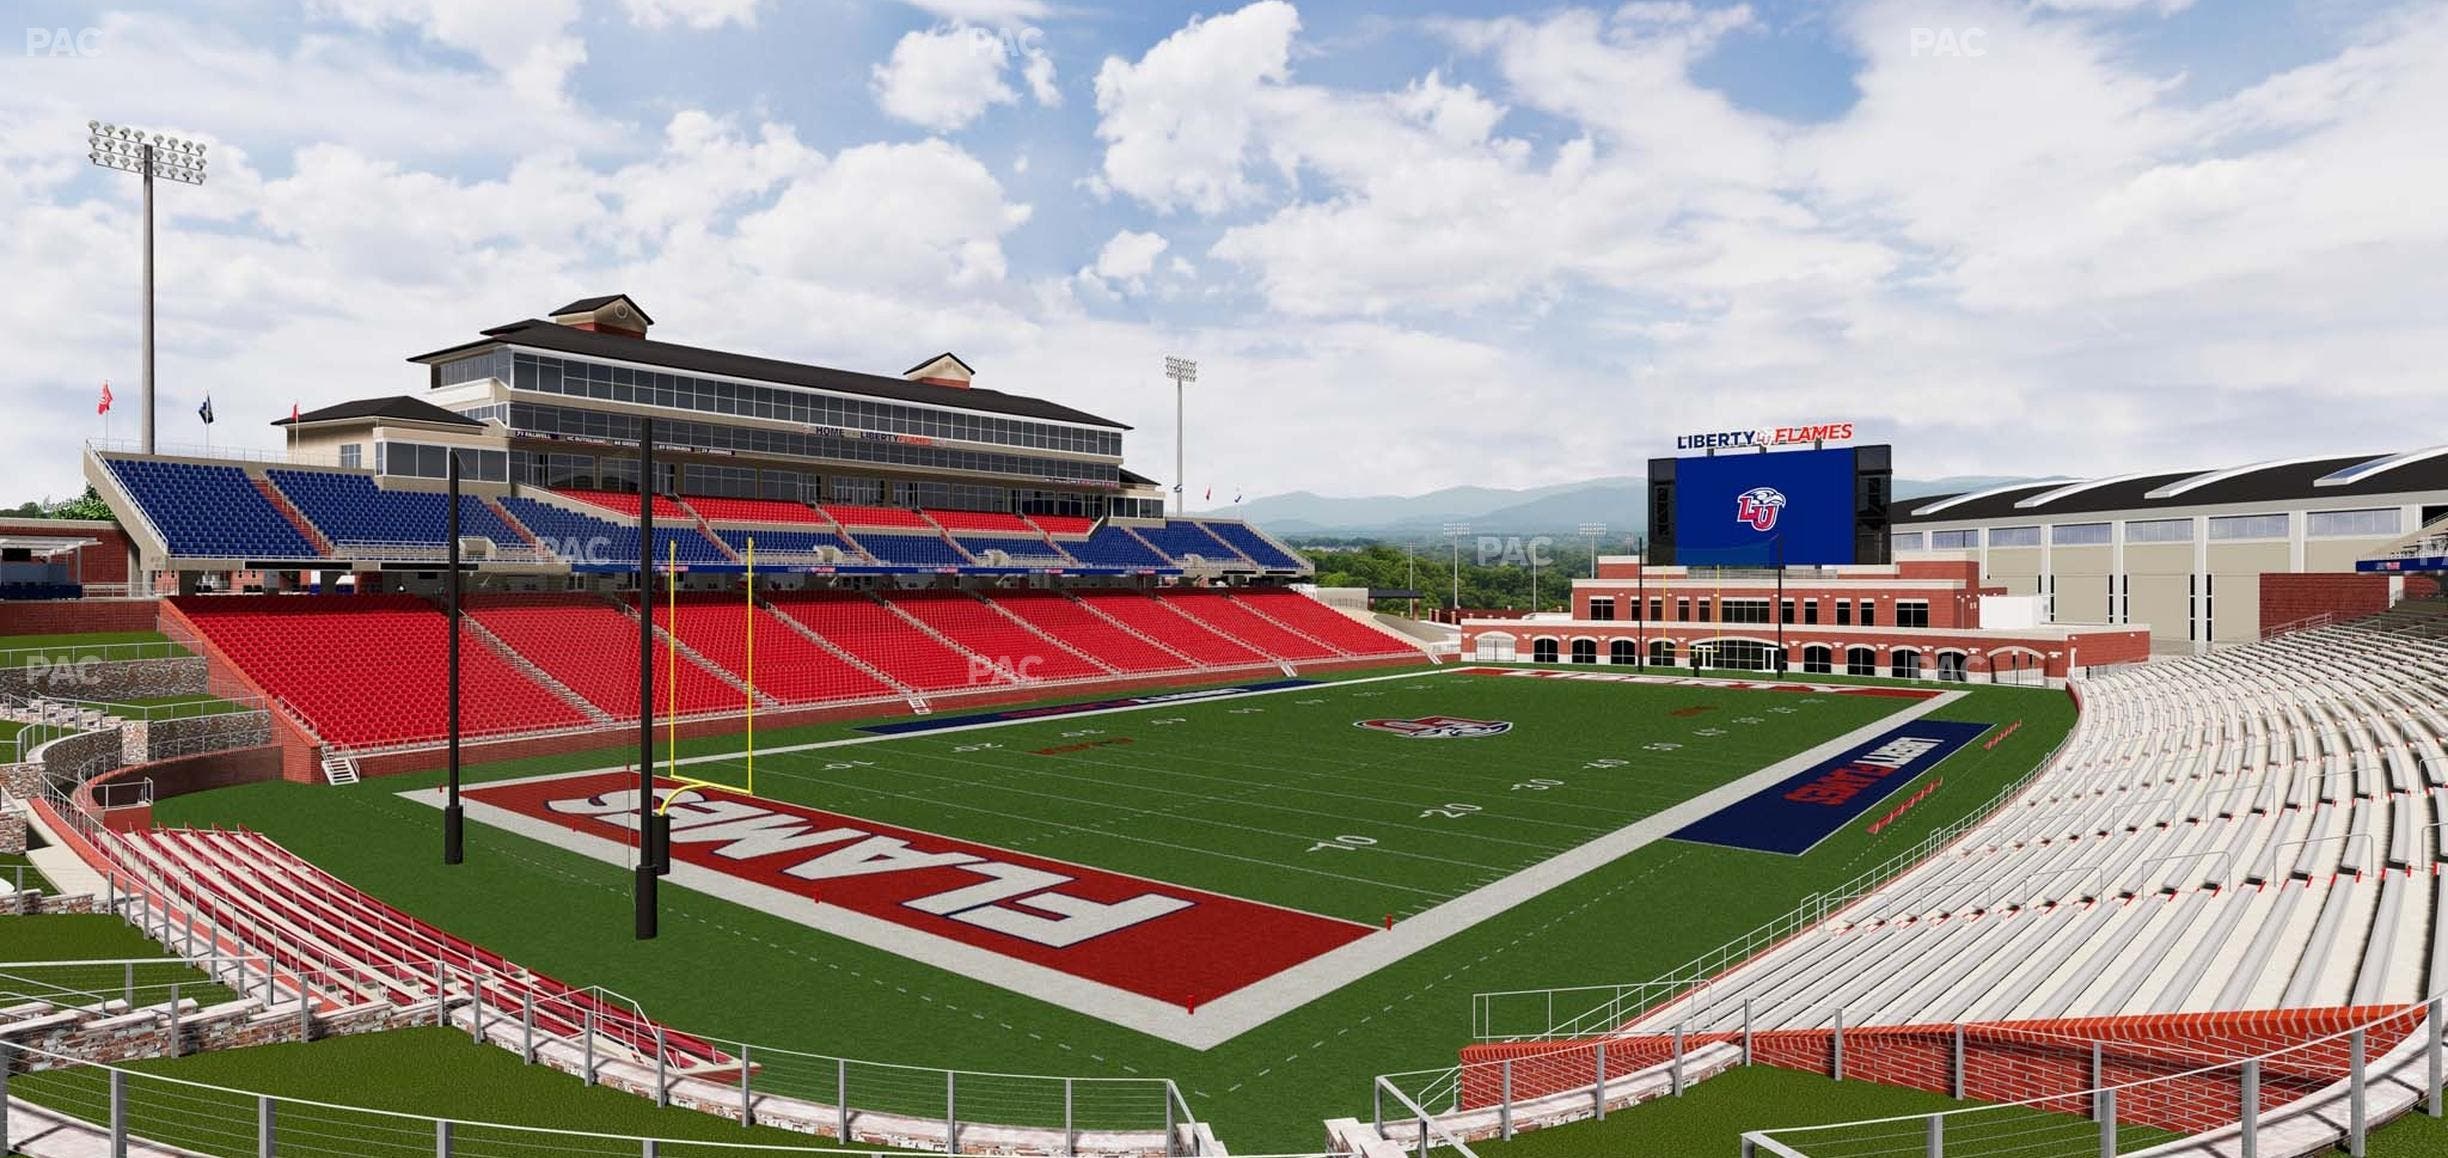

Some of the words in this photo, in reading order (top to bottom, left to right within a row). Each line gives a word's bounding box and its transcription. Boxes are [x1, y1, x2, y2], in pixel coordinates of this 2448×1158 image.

[815, 426, 845, 438] HOME
[860, 431, 898, 443] LIBERTY
[1677, 430, 1757, 449] LIBERTY
[1774, 423, 1855, 444] FLAMES
[1737, 495, 1779, 532] LU
[1513, 778, 1565, 791] 30
[1424, 802, 1483, 819] 20
[1316, 835, 1378, 852] 10
[545, 788, 1199, 949] FLAMES
